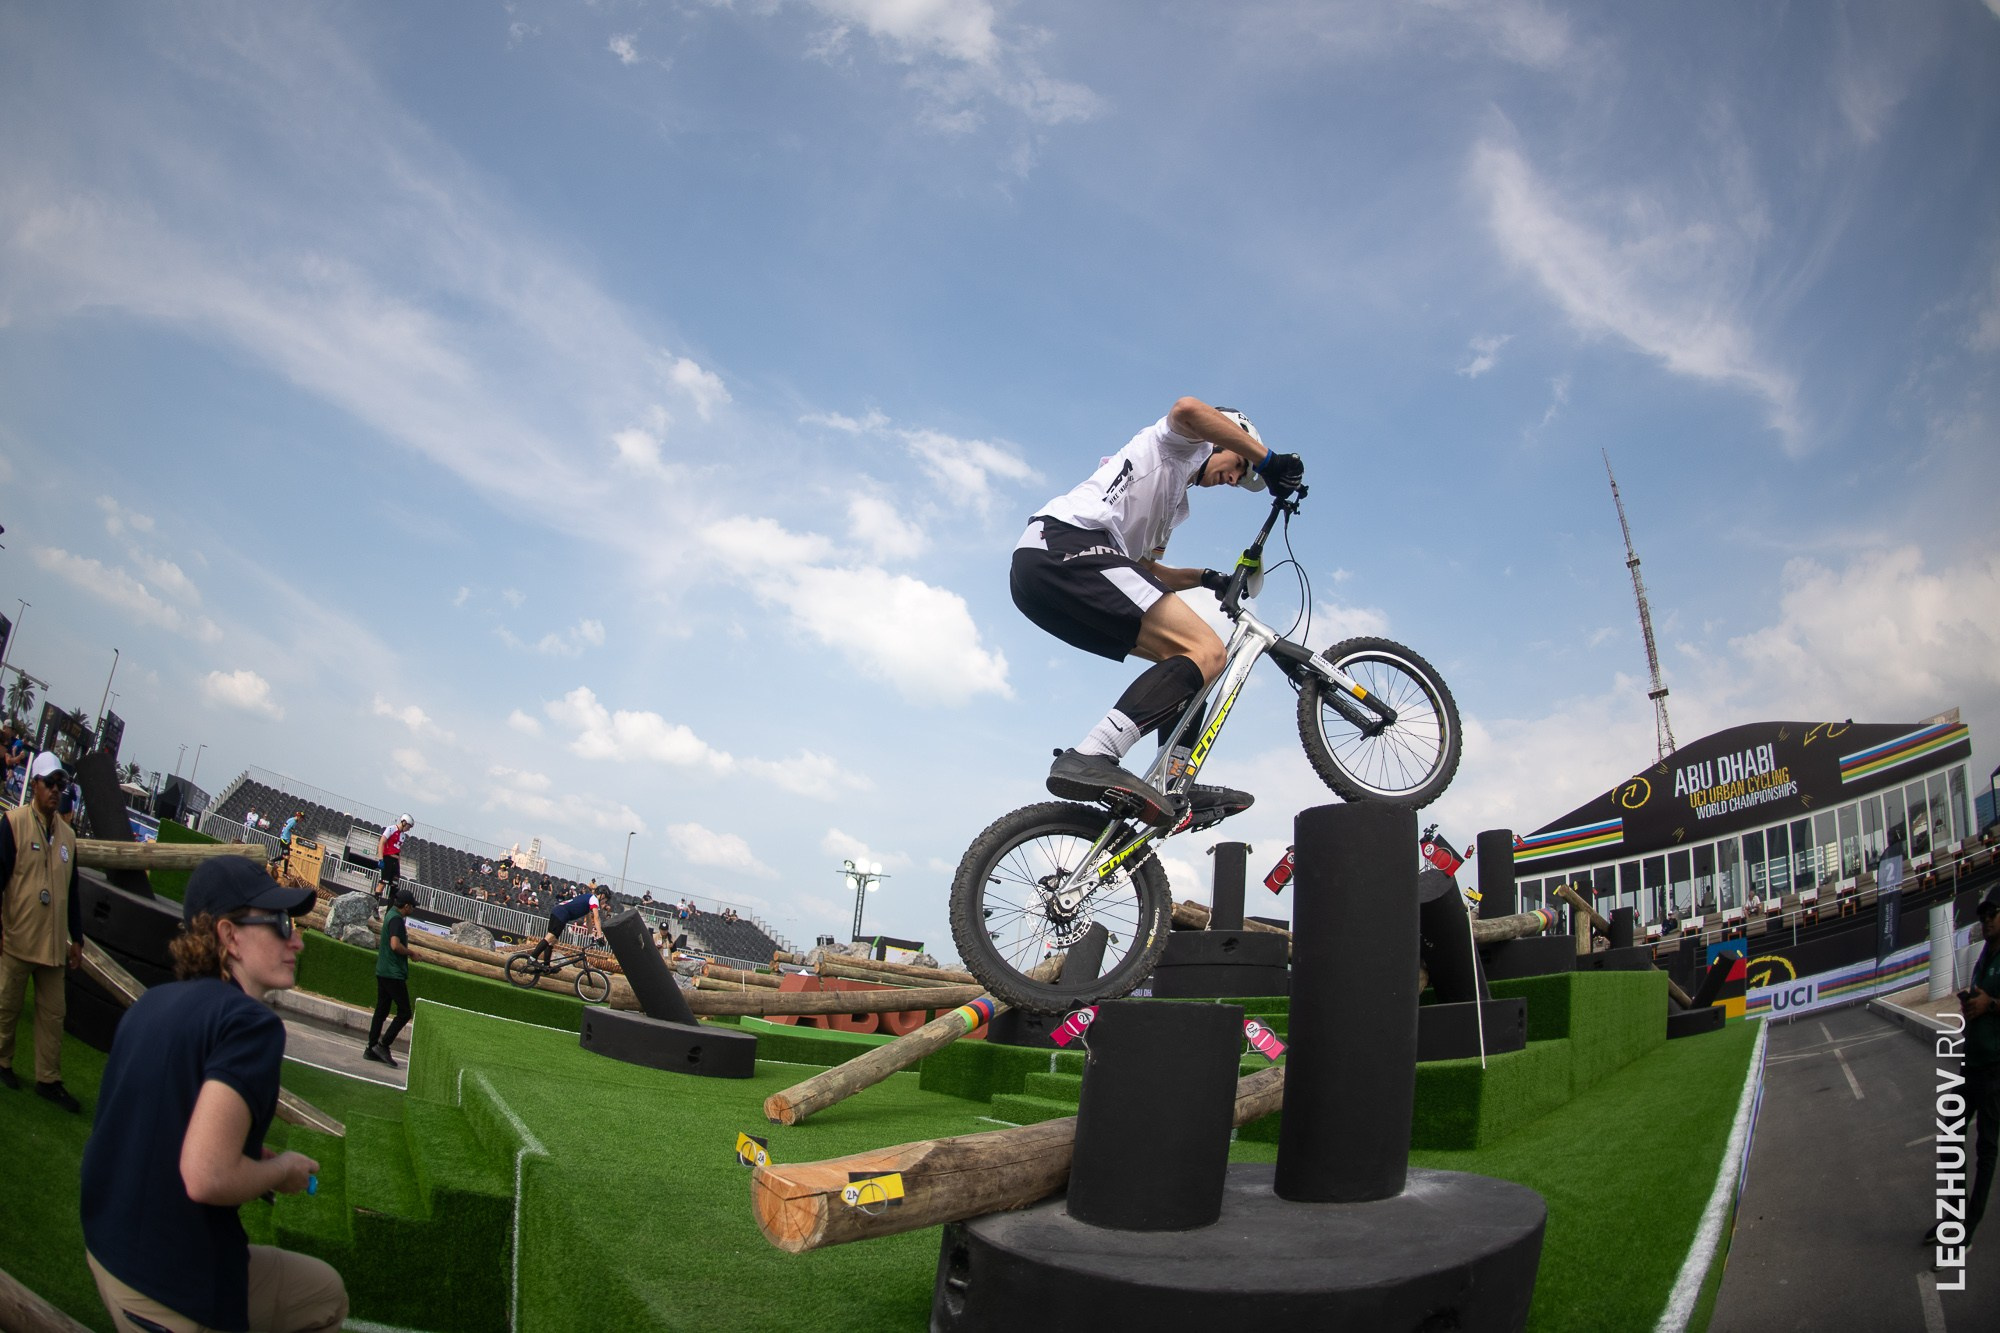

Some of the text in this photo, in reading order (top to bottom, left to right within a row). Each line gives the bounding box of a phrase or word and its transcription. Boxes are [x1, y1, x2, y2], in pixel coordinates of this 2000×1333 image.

[1674, 742, 1776, 798] ABU DHABI
[1689, 766, 1790, 808] UCI URBAN CYCLING
[1696, 780, 1798, 820] WORLD CHAMPIONSHIPS
[1885, 862, 1895, 882] 2
[1773, 984, 1813, 1011] UCI
